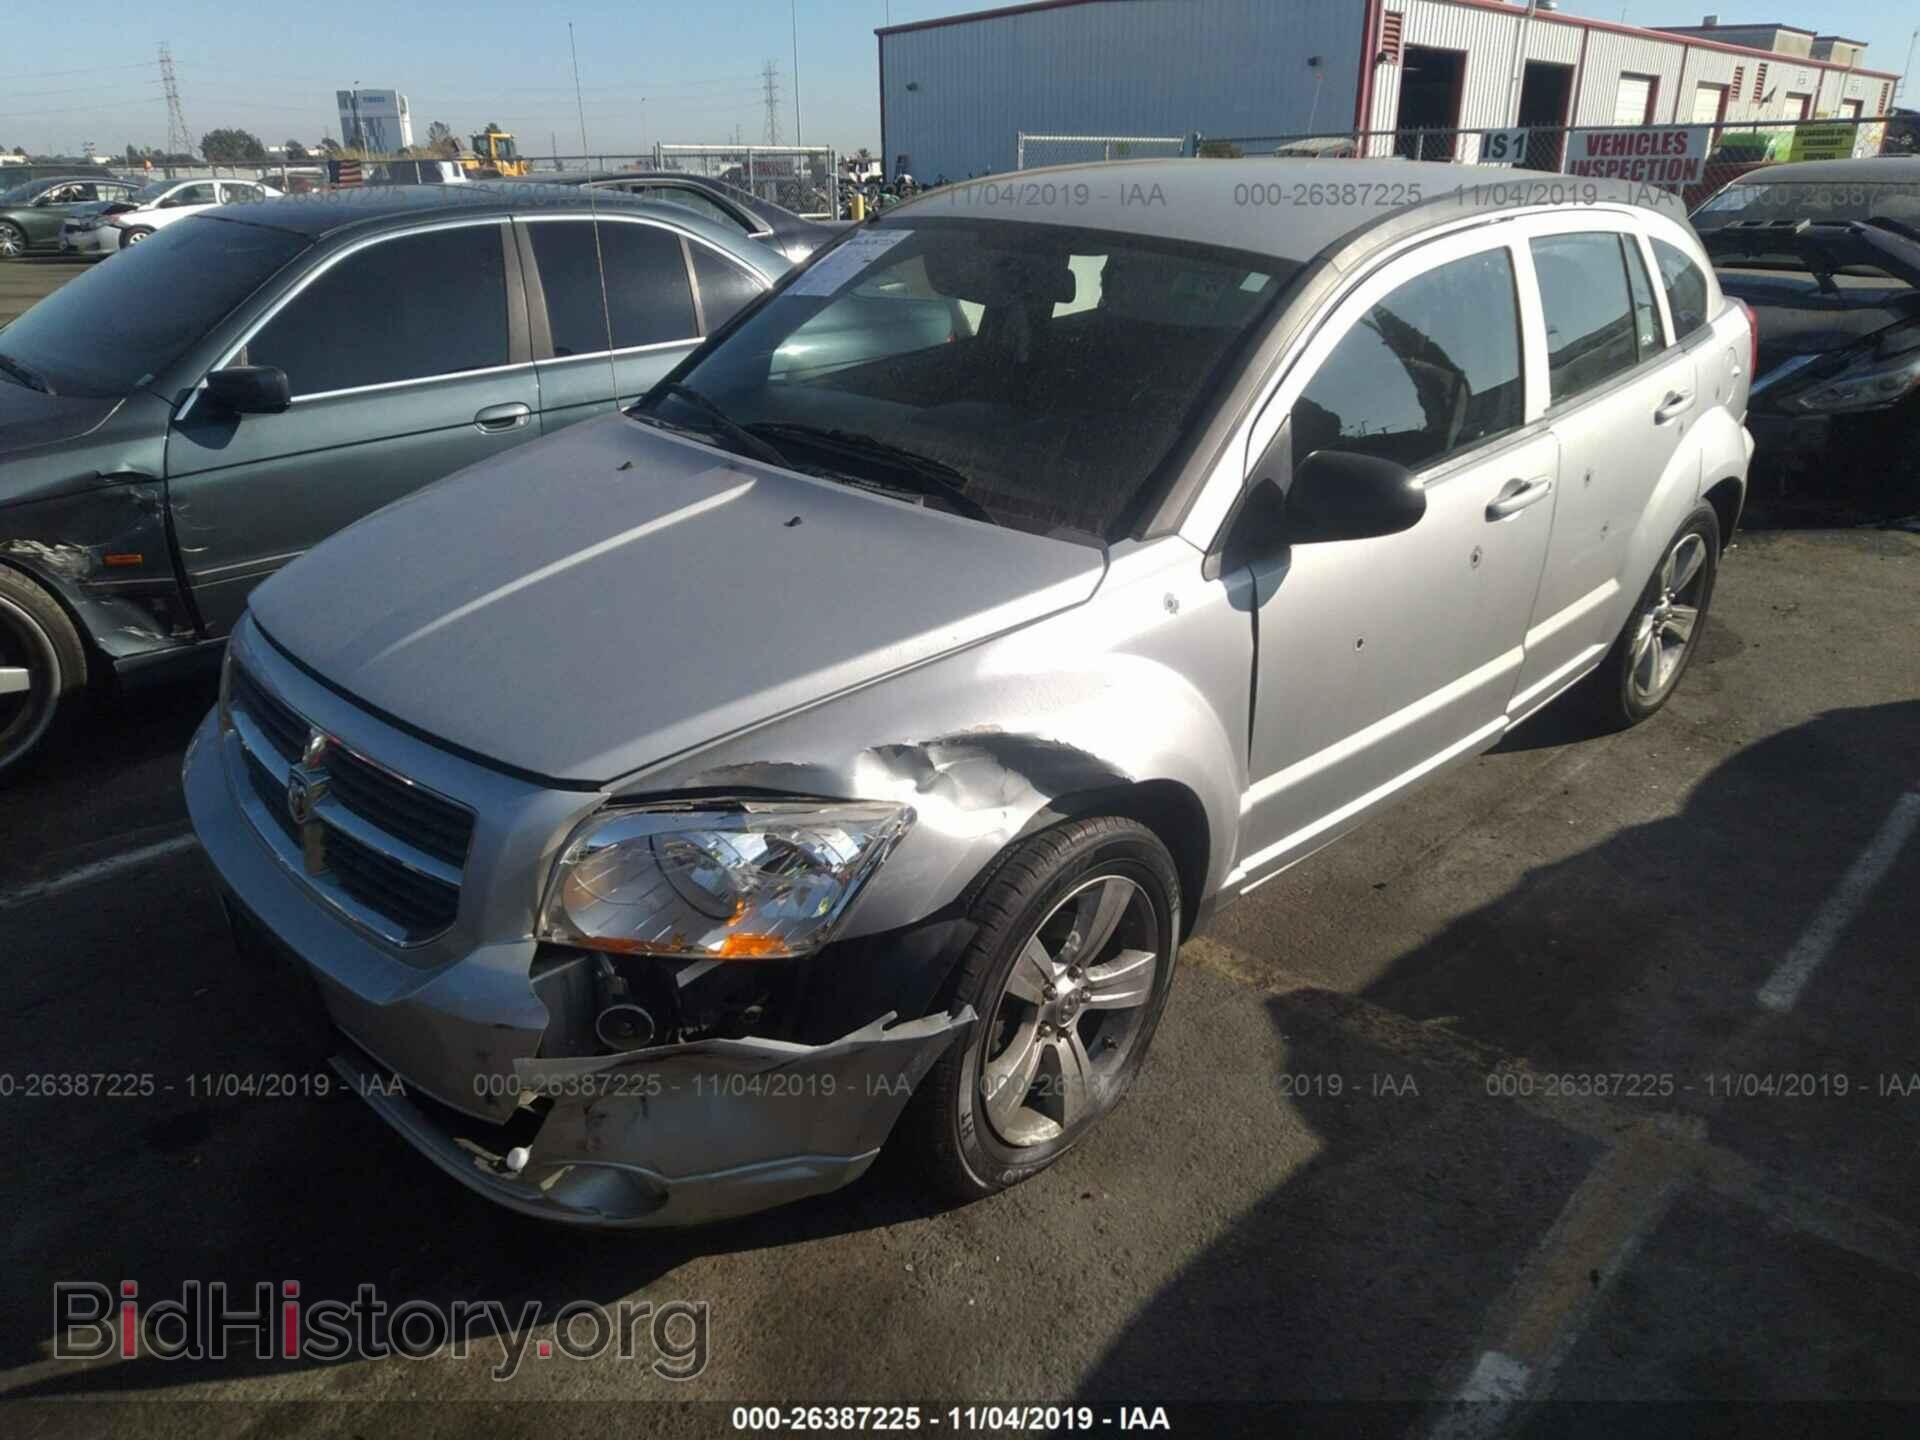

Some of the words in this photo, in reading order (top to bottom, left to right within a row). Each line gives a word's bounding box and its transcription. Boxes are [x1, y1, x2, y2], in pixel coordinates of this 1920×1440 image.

[1482, 133, 1509, 159] IS
[1513, 132, 1527, 159] 1
[1585, 131, 1689, 156] VEHICLES
[1570, 157, 1700, 183] INSPECTION
